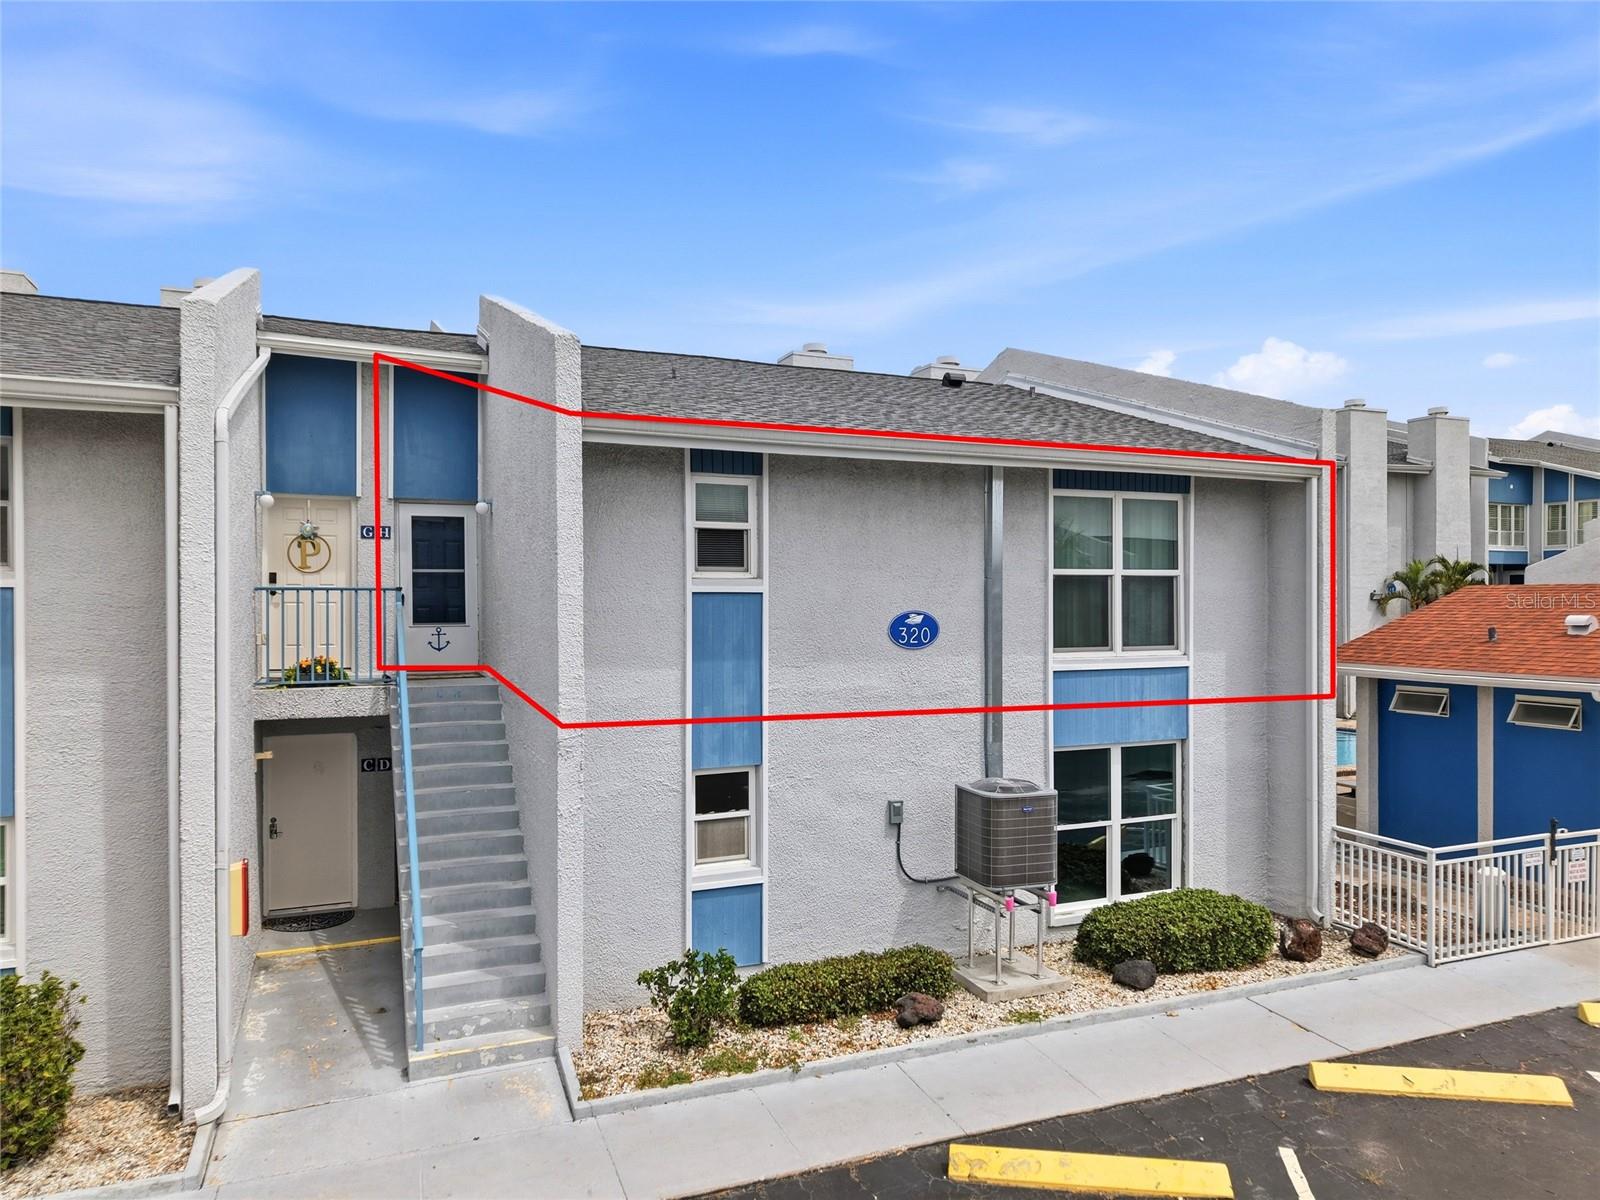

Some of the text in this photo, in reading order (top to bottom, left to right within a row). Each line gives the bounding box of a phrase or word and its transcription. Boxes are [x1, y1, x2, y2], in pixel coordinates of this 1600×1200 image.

[363, 526, 373, 538] G
[297, 539, 321, 570] P
[898, 627, 931, 644] 320
[363, 759, 373, 771] C
[379, 759, 390, 770] D
